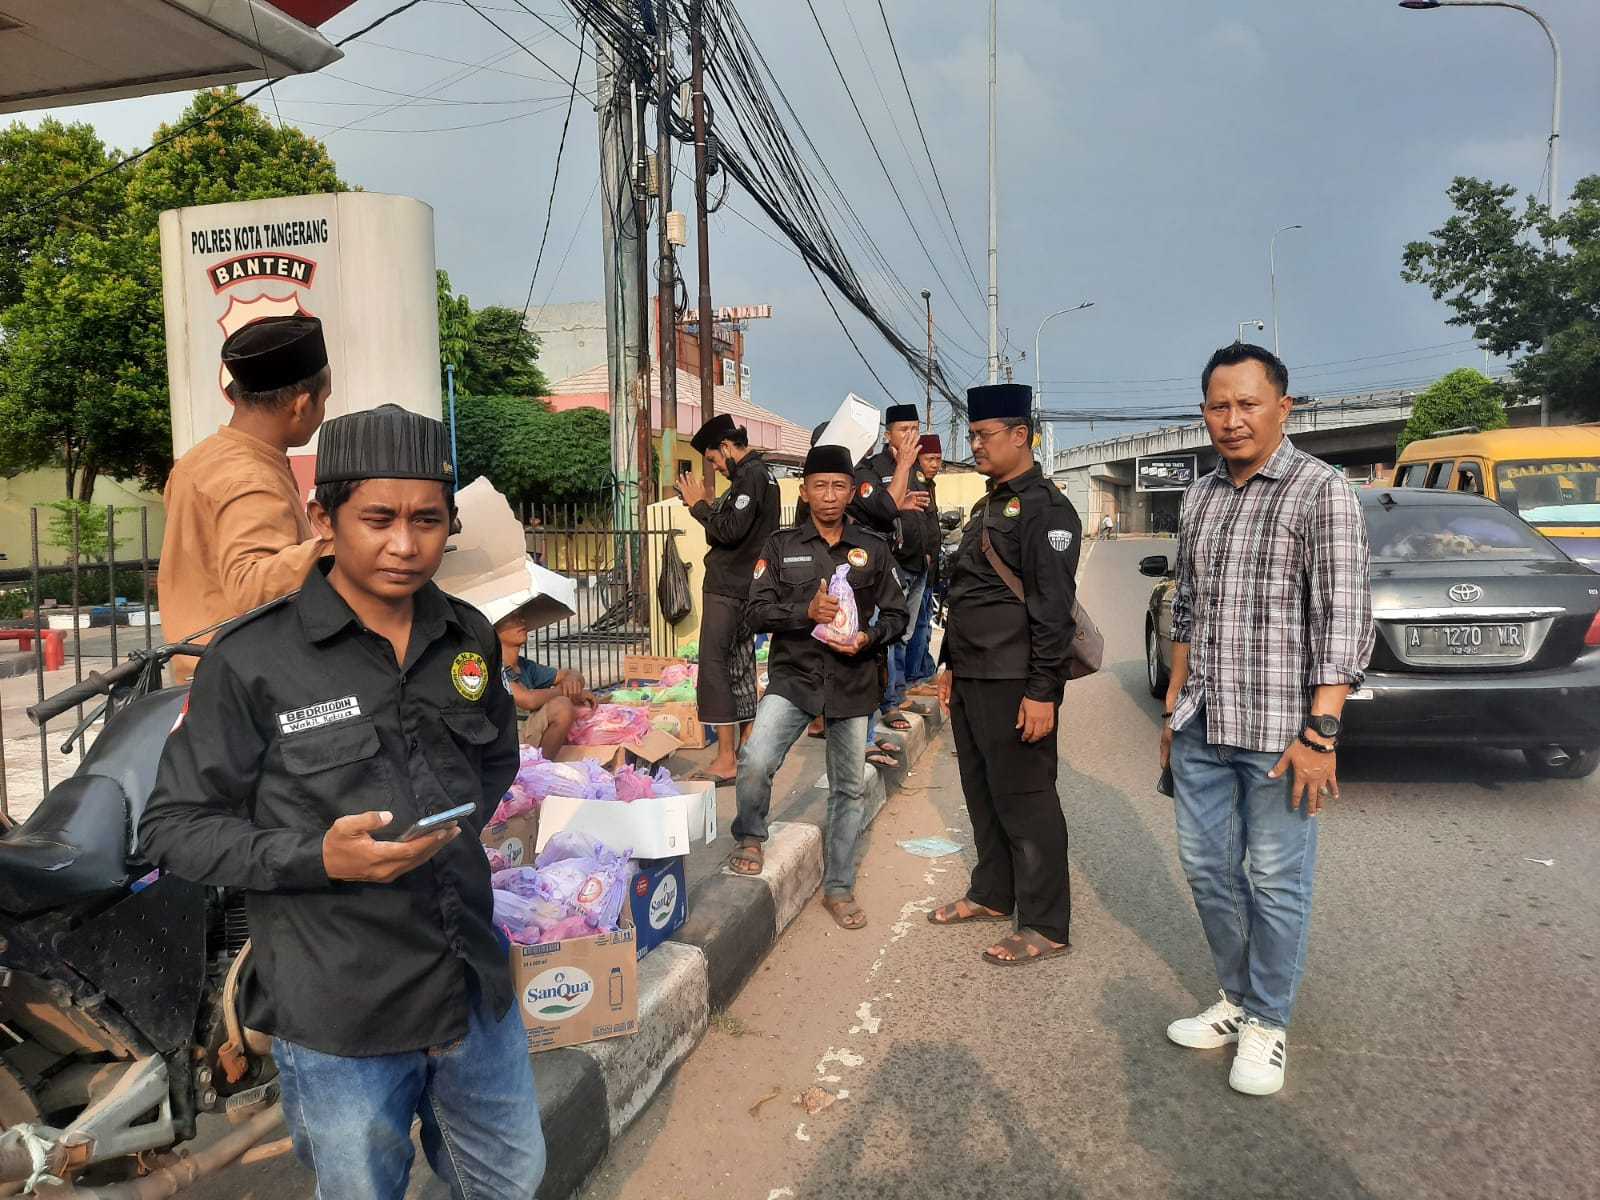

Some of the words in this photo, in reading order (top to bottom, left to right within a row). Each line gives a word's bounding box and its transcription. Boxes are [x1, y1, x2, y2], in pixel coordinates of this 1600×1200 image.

[191, 227, 232, 255] POLRES
[234, 225, 263, 251] KOTA
[264, 218, 329, 249] TANGERANG
[214, 257, 306, 285] BANTEN
[1411, 627, 1422, 647] A
[1444, 626, 1482, 647] 1270
[526, 980, 590, 1004] SanQua
